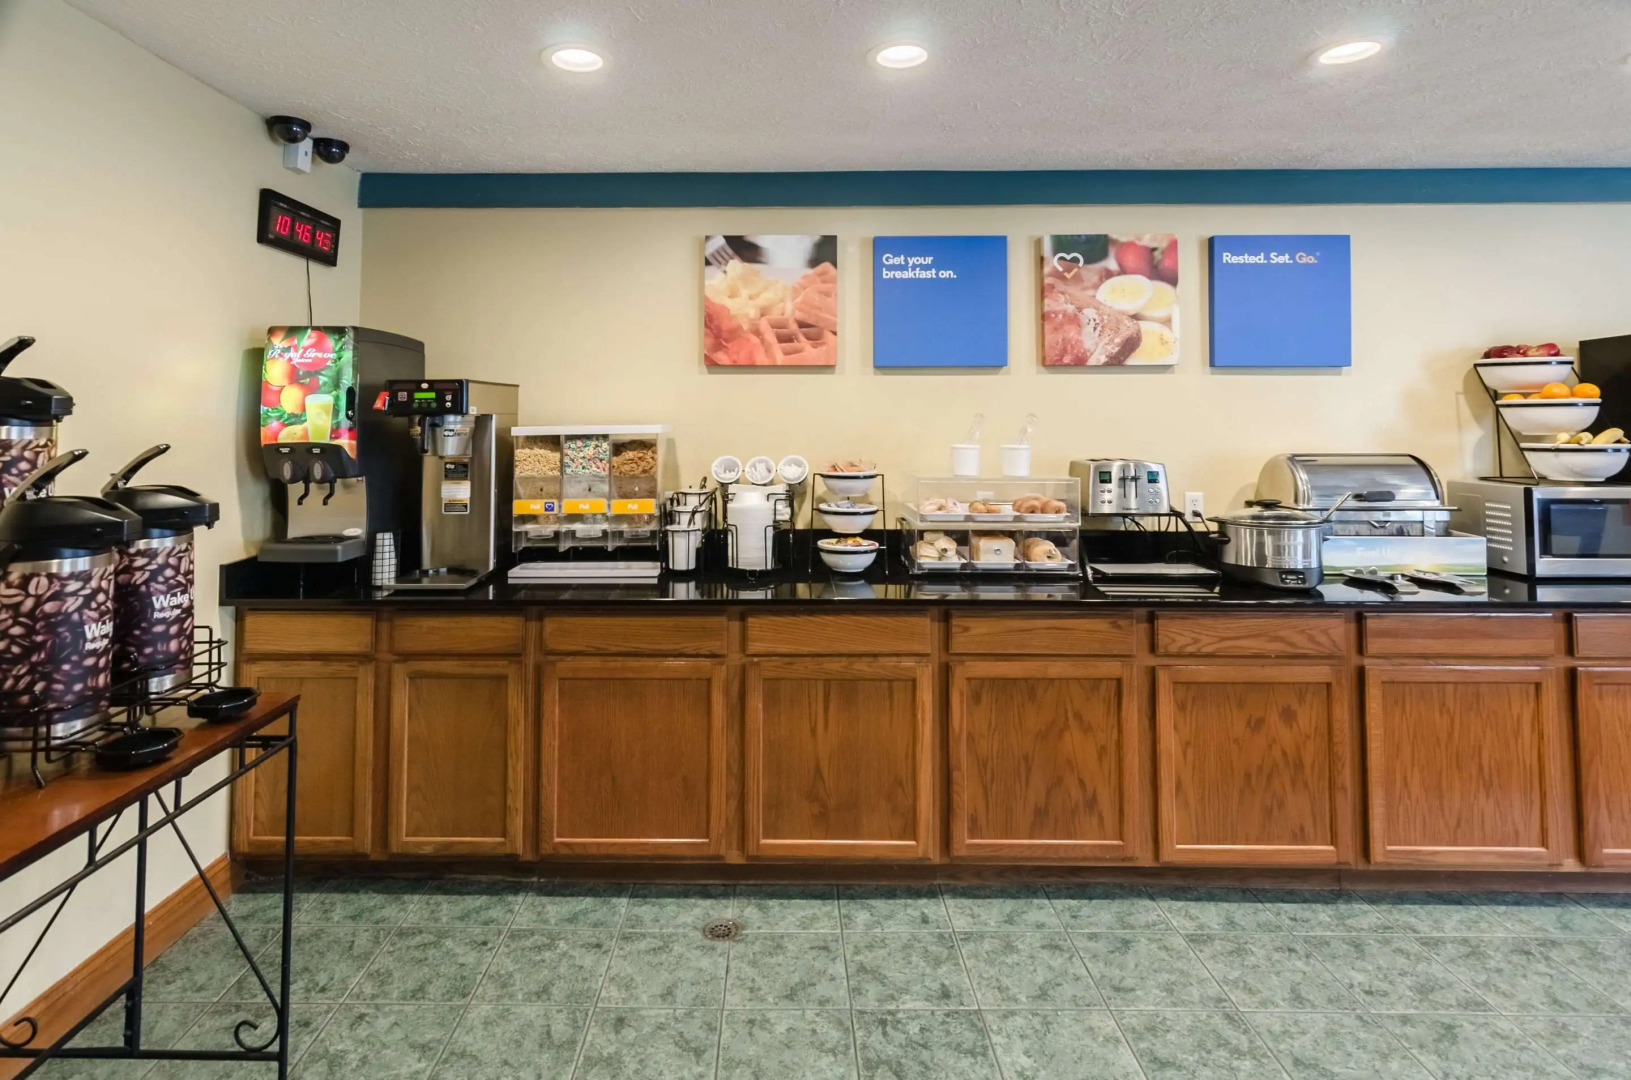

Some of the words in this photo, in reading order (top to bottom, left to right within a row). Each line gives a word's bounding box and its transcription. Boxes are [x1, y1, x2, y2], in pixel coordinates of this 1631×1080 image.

[275, 215, 291, 236] 10
[295, 221, 312, 244] 46
[882, 253, 905, 265] Get
[907, 255, 934, 267] your
[1222, 252, 1267, 264] Rested.
[1269, 252, 1293, 264] Set.
[882, 267, 936, 279] breakfast
[938, 270, 957, 279] on.
[152, 591, 189, 609] Wake
[84, 619, 113, 640] Wak
